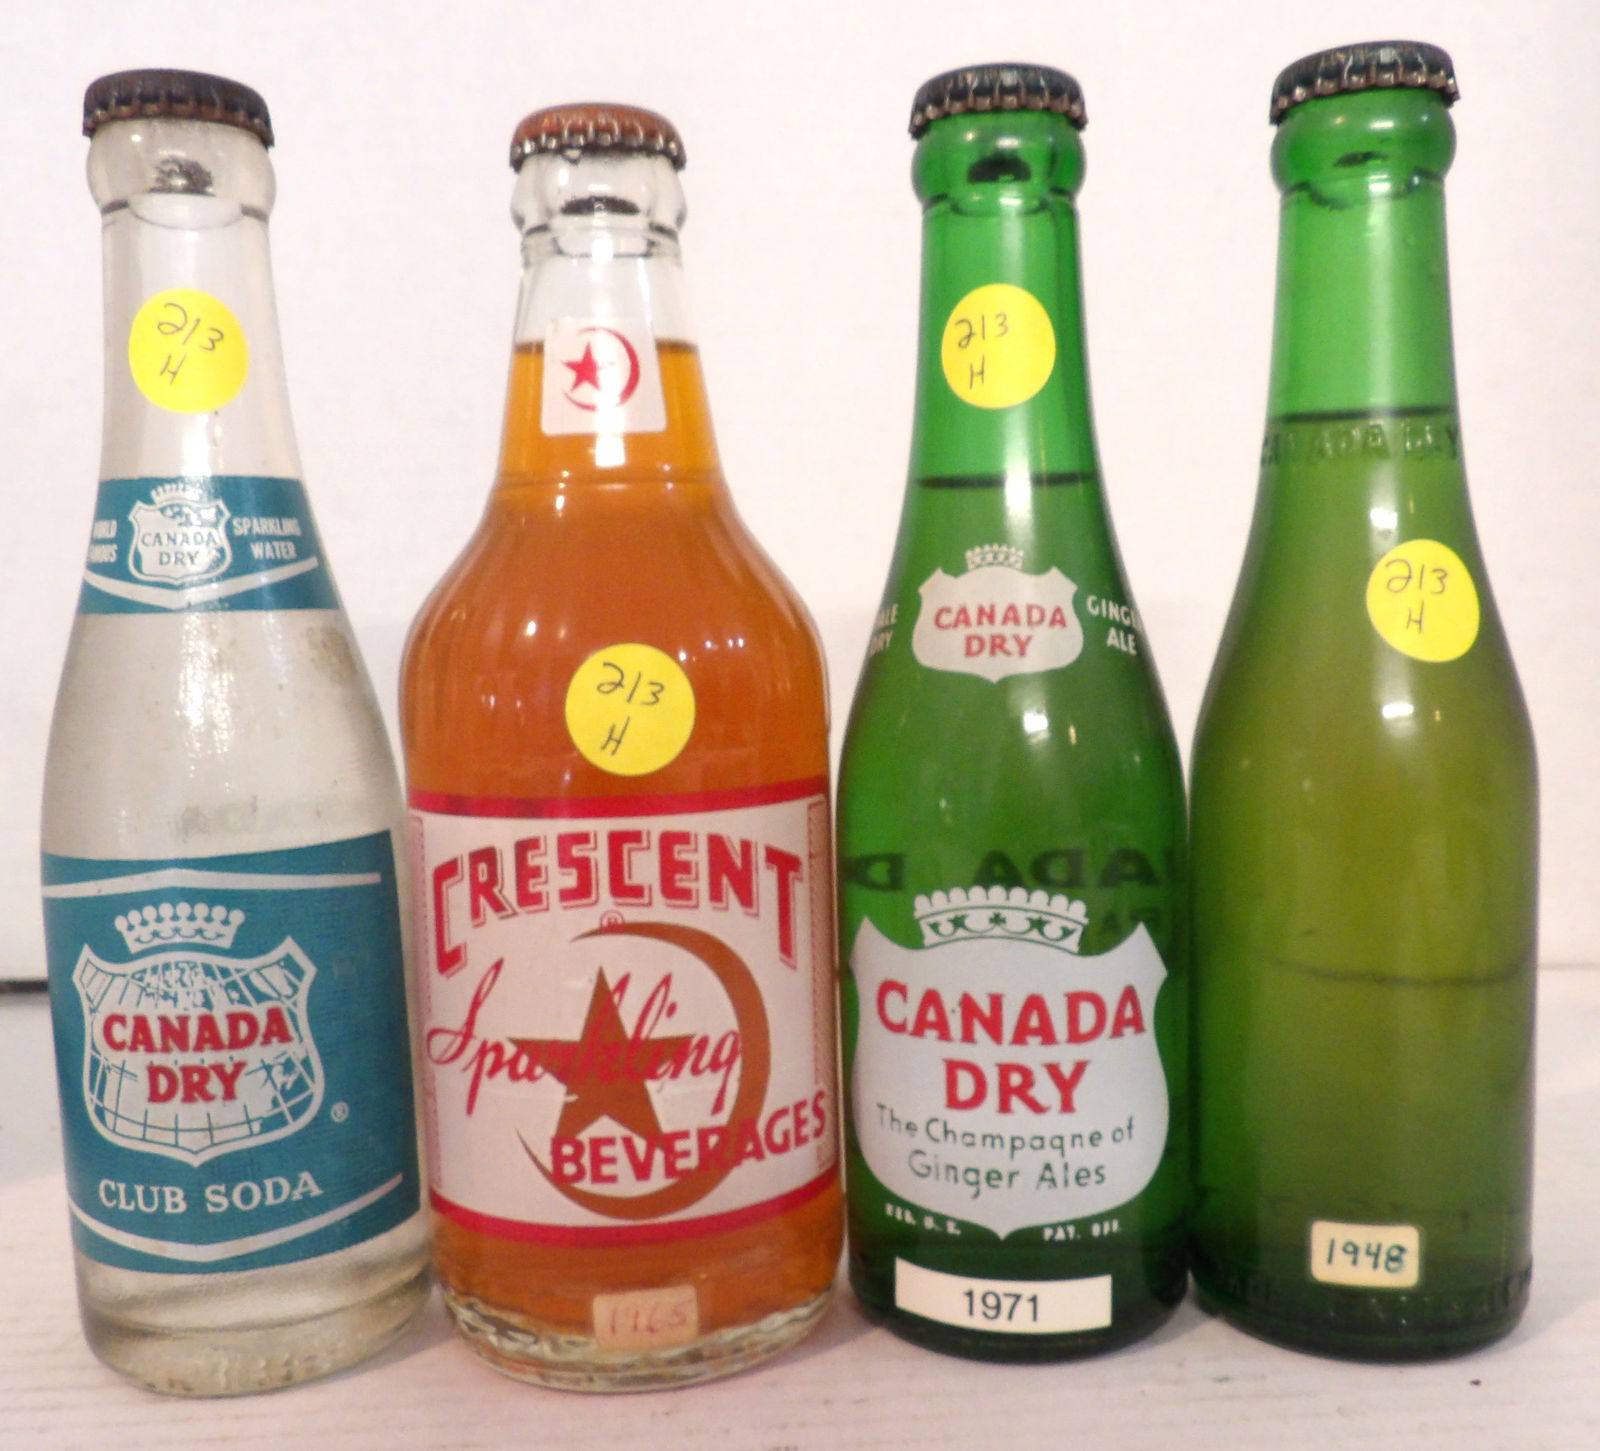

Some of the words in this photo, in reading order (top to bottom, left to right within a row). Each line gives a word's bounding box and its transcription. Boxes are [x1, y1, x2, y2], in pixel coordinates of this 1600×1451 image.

[157, 302, 225, 352] 213
[953, 312, 1010, 349] 213
[159, 352, 188, 386] H
[968, 354, 986, 391] H
[141, 530, 220, 549] CANADA
[158, 551, 200, 567] DRY
[250, 541, 299, 561] WATER
[1385, 558, 1449, 596] 213
[933, 602, 1068, 630] CANADA
[1406, 599, 1426, 635] H
[963, 633, 1034, 658] DRY
[1106, 626, 1138, 657] ALE
[596, 661, 665, 706] 213
[600, 715, 631, 757] H
[432, 829, 805, 978] CRESCENT
[102, 1005, 295, 1054] CANADA
[876, 978, 1146, 1047] CANADA
[426, 957, 743, 1117] Sparkling
[146, 1060, 248, 1104] DRY
[942, 1057, 1090, 1115] DRY
[550, 1090, 827, 1186] BEVERAGES
[876, 1102, 919, 1137] The
[1111, 1115, 1135, 1145] of
[99, 1178, 188, 1214] CLUB
[205, 1170, 324, 1214] SODA
[907, 1148, 1020, 1199] Ginger
[1035, 1162, 1107, 1191] Ales
[962, 1289, 1041, 1323] 1971
